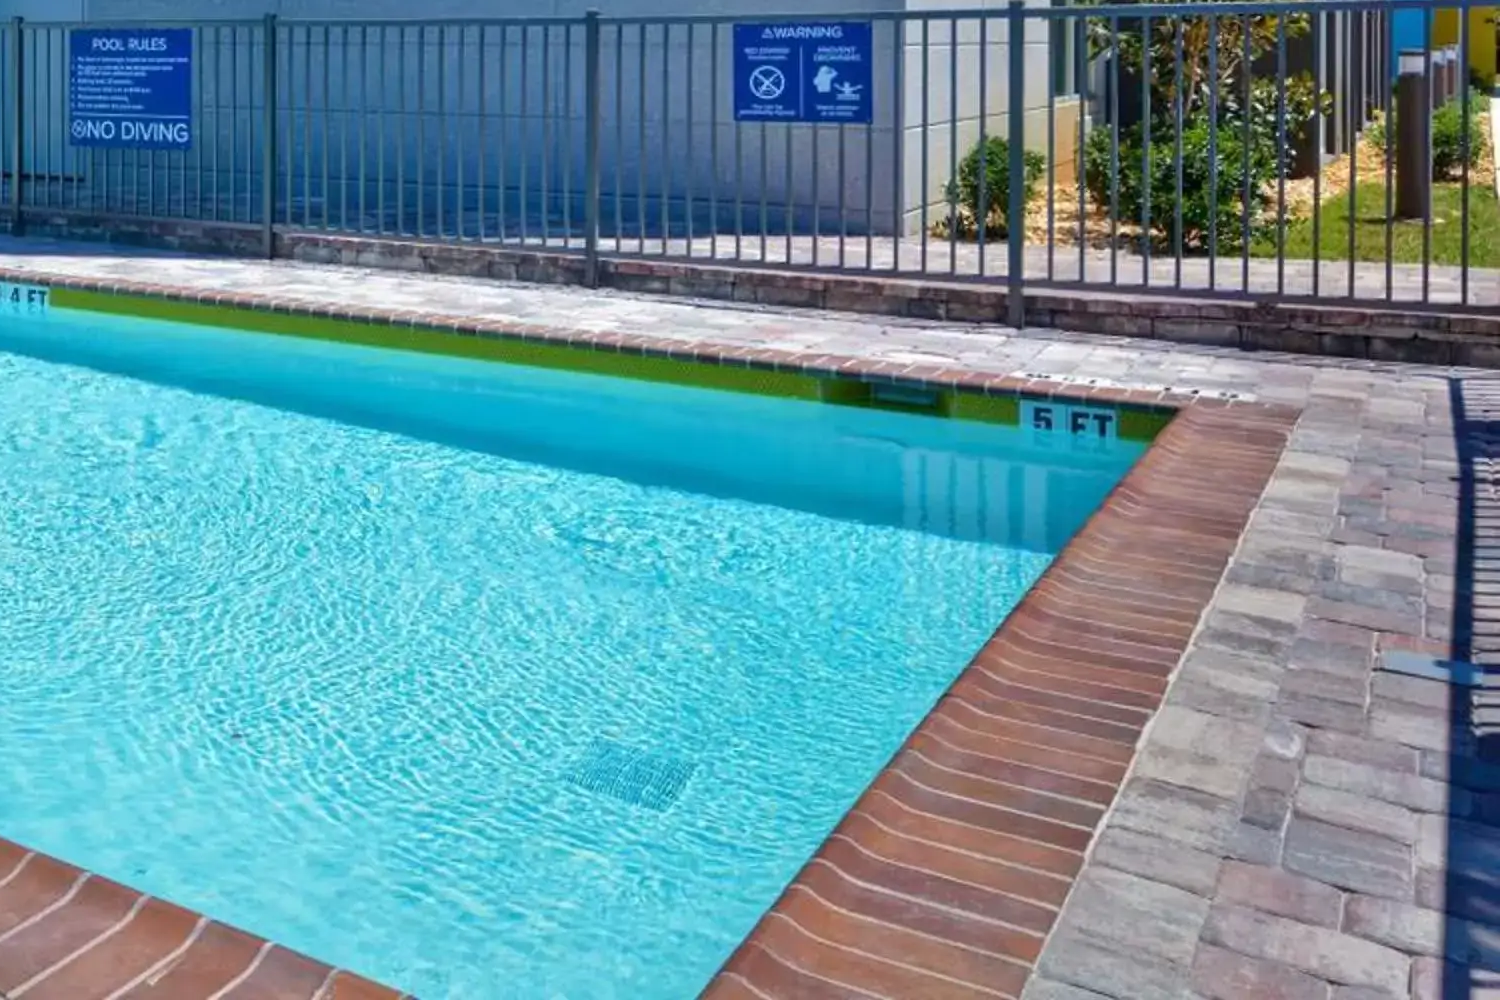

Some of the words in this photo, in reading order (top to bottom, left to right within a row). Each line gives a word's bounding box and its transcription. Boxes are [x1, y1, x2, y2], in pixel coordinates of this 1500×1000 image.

[774, 25, 843, 39] WARNING
[92, 37, 125, 51] POOL
[128, 37, 167, 51] RULES
[87, 119, 116, 140] NO
[121, 121, 190, 143] DIVING
[27, 288, 48, 307] FT
[1033, 407, 1053, 431] 5
[1071, 411, 1113, 438] FT
